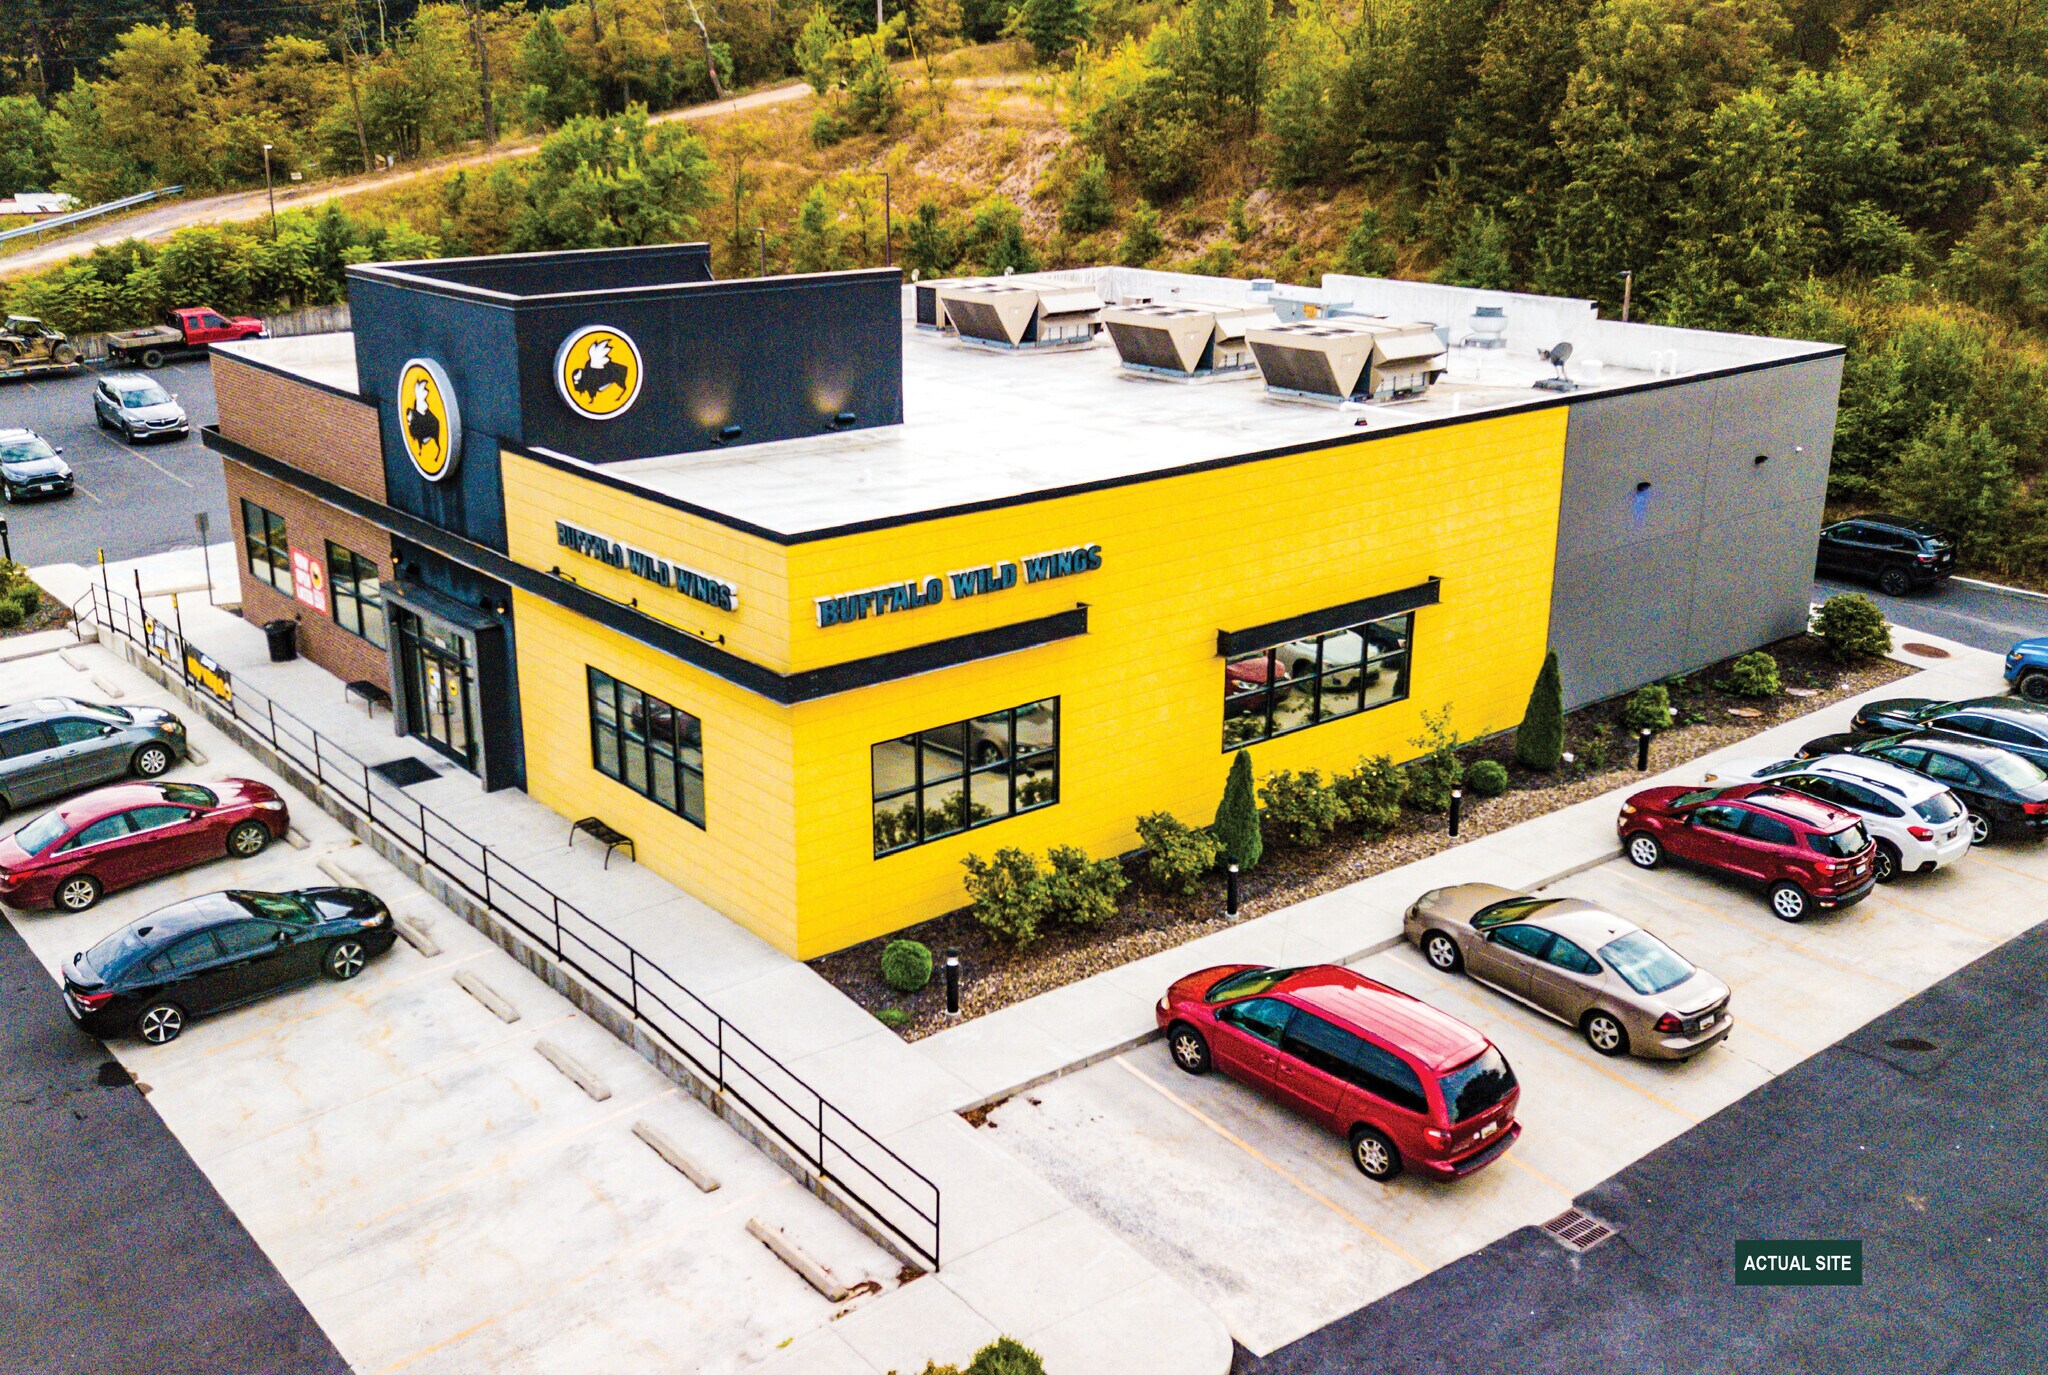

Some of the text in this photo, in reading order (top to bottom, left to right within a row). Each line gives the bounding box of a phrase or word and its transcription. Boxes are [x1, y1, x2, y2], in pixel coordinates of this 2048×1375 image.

[556, 521, 735, 612] BUFFALO WILD WINGS
[816, 544, 1102, 627] BUFFALO WILD WINGS
